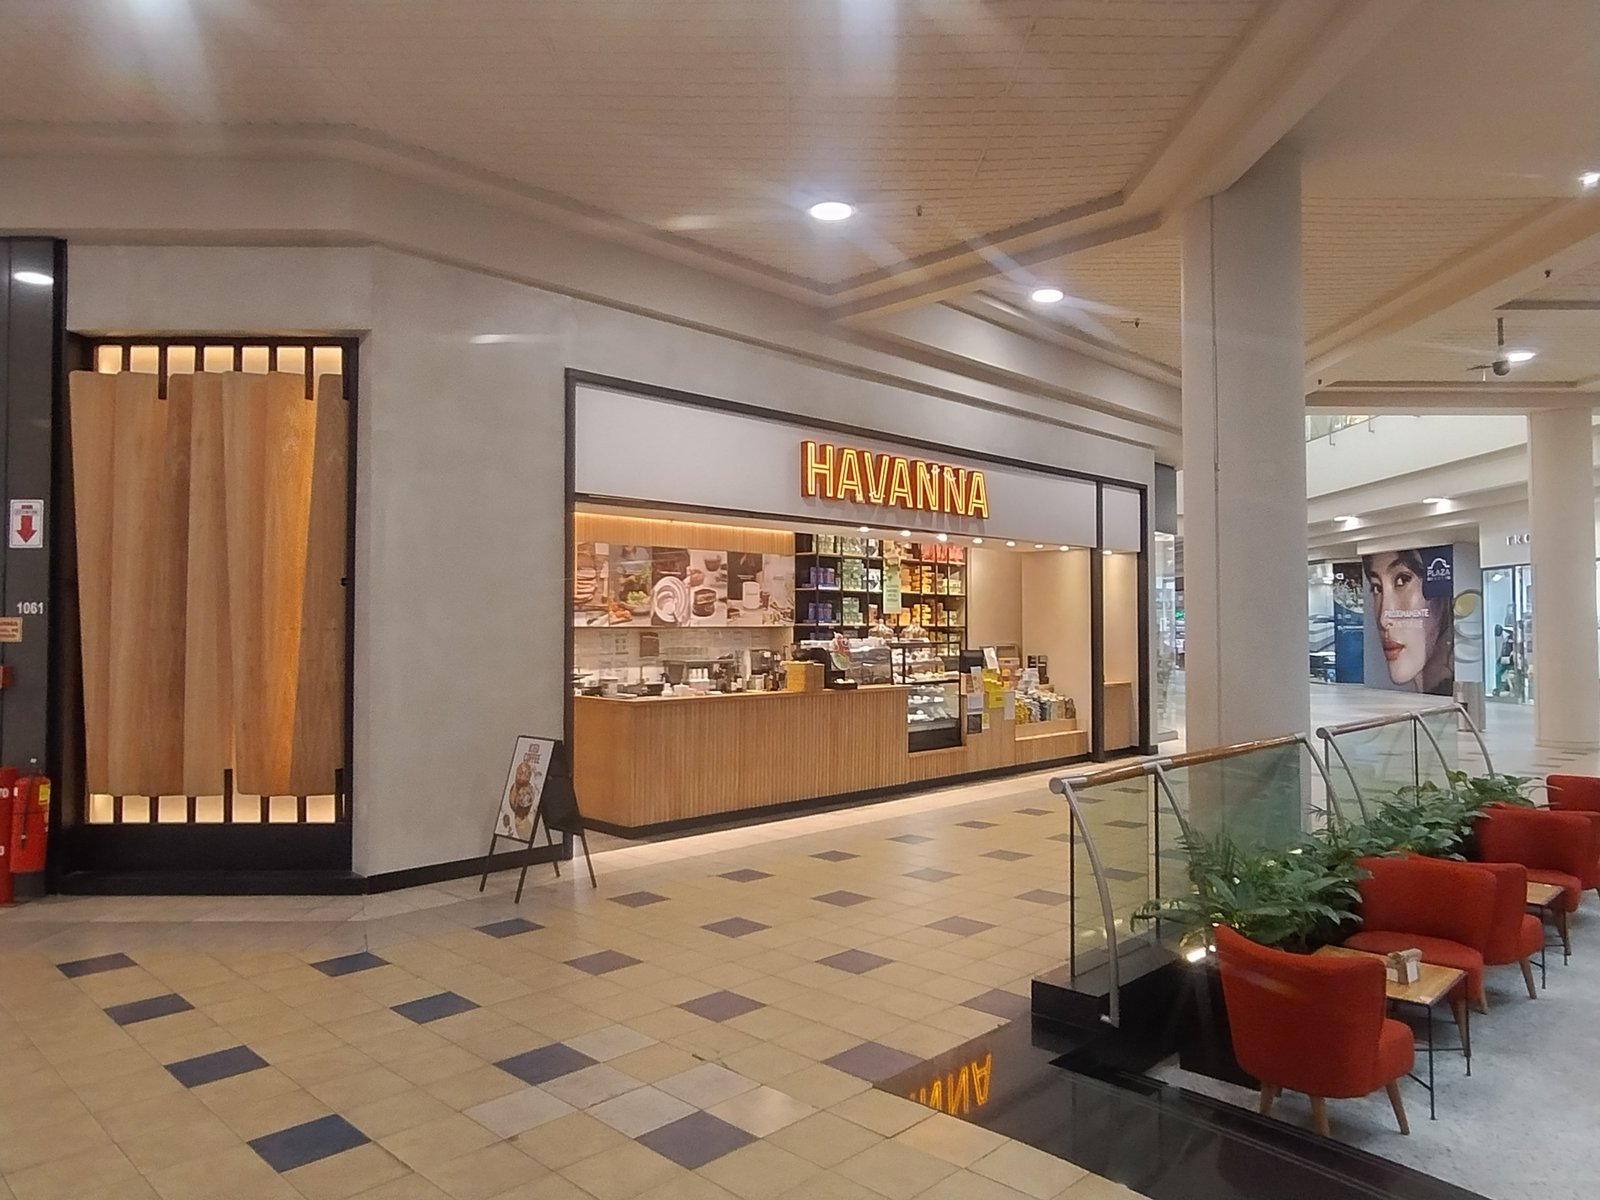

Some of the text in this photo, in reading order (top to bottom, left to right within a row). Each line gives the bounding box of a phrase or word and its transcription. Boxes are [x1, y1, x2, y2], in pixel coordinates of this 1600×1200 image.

[801, 440, 989, 519] HAVANNA
[1426, 568, 1451, 577] PLAZA
[16, 601, 44, 614] 1061
